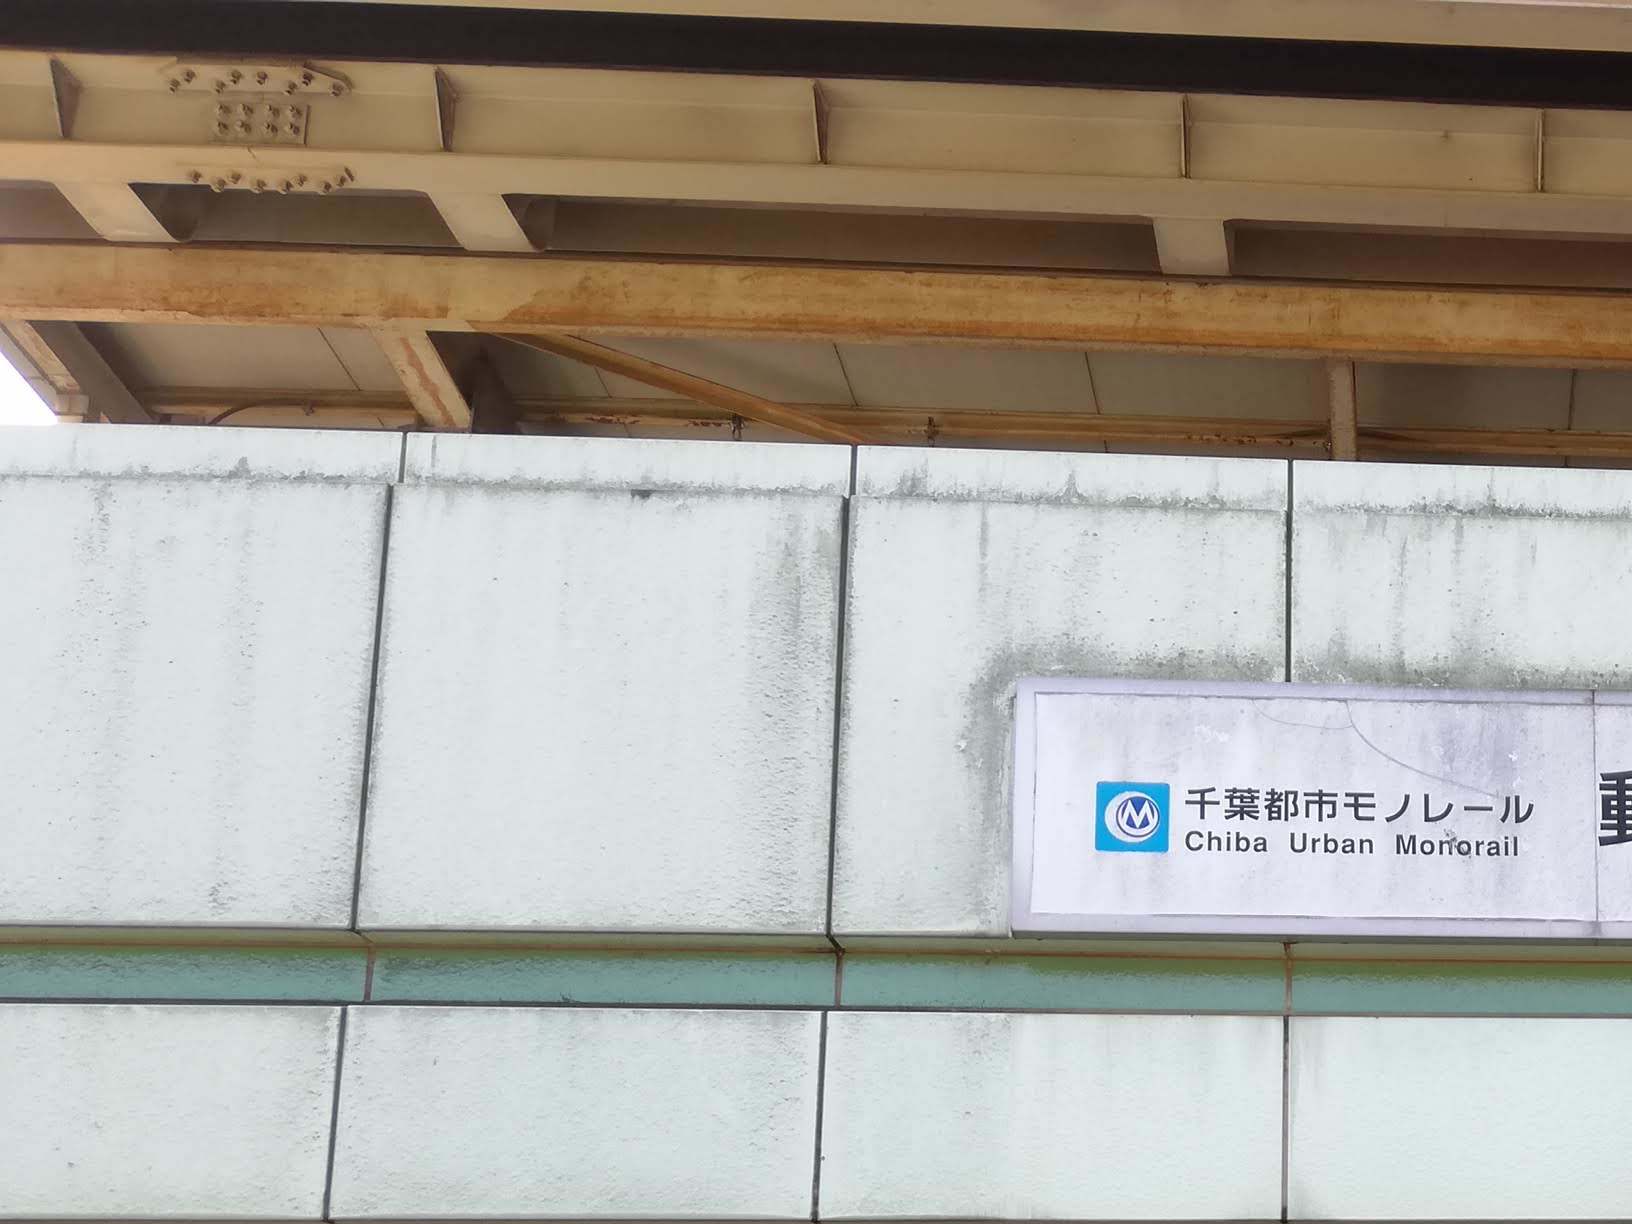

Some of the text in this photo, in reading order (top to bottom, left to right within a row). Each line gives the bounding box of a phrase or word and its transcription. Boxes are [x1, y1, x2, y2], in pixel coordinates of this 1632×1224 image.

[1185, 786, 1534, 825] 千葉都市モノレール
[1184, 830, 1519, 858] Chiba Urban Monorail
